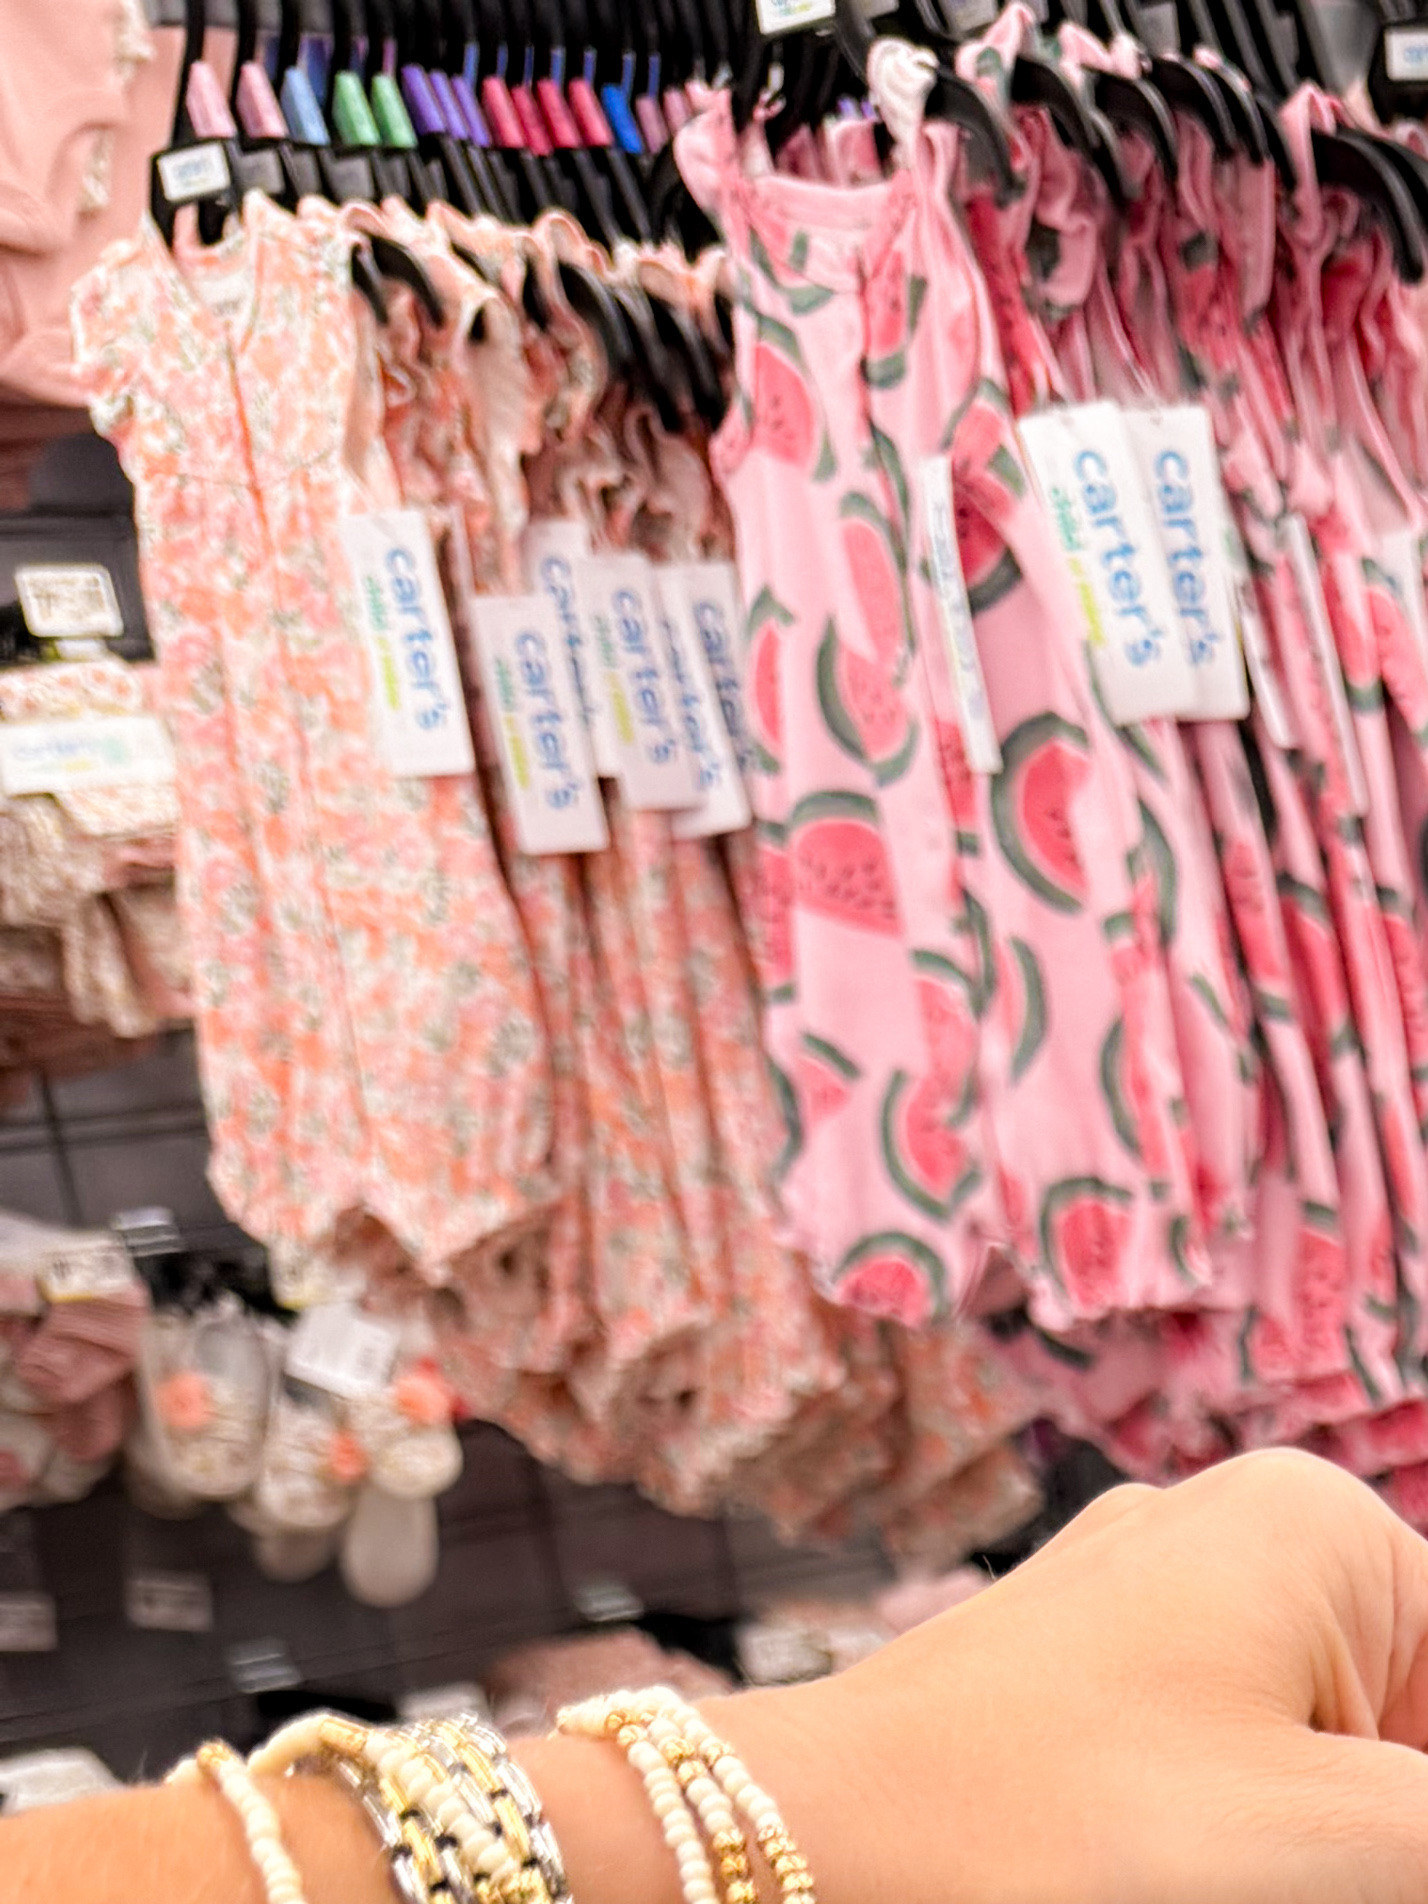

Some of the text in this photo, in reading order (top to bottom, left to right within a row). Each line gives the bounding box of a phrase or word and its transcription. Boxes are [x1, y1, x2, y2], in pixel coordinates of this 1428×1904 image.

[386, 547, 447, 730] carter's
[1074, 450, 1164, 666] carter's
[515, 630, 580, 810] carter's
[614, 589, 676, 764] carter's
